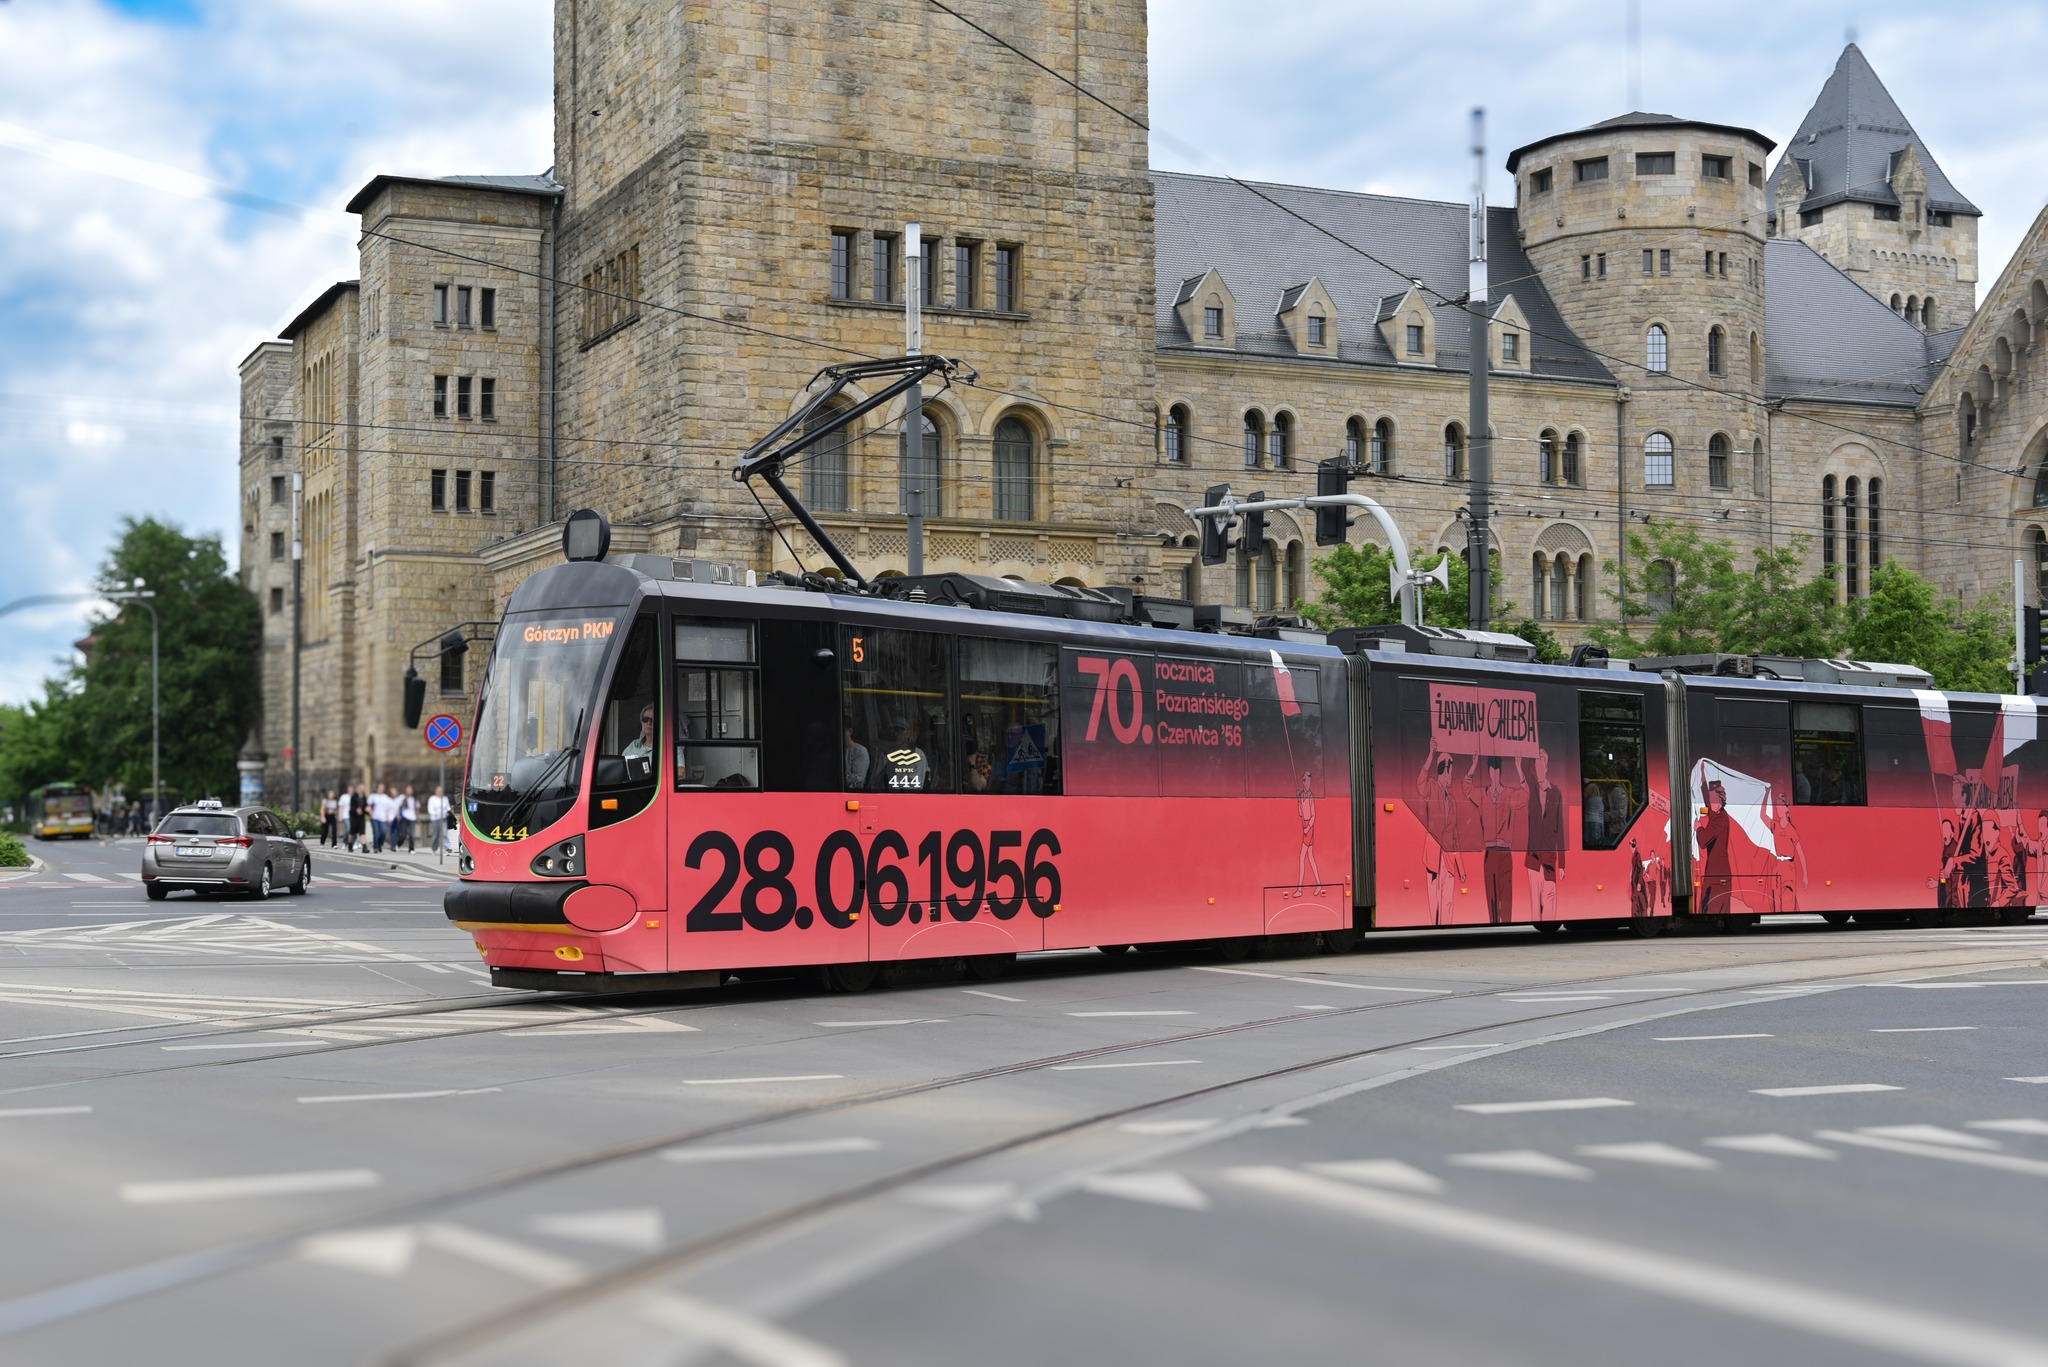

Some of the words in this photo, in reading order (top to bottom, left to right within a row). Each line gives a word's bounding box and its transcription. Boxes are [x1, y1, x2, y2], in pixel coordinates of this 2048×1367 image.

[524, 625, 579, 644] Górczyn
[583, 622, 614, 639] PKM
[852, 637, 864, 662] 5
[1155, 660, 1215, 683] rocznica
[1077, 656, 1154, 744] 70.
[1156, 689, 1249, 721] Poznańskiego
[1435, 692, 1485, 736] ŻĄDAMY
[1487, 699, 1536, 743] CHLEBA
[1157, 721, 1219, 746] Czerwca
[493, 775, 505, 787] 22
[888, 775, 921, 788] 444
[490, 825, 529, 840] 444
[684, 828, 1062, 932] 28.06.1956
